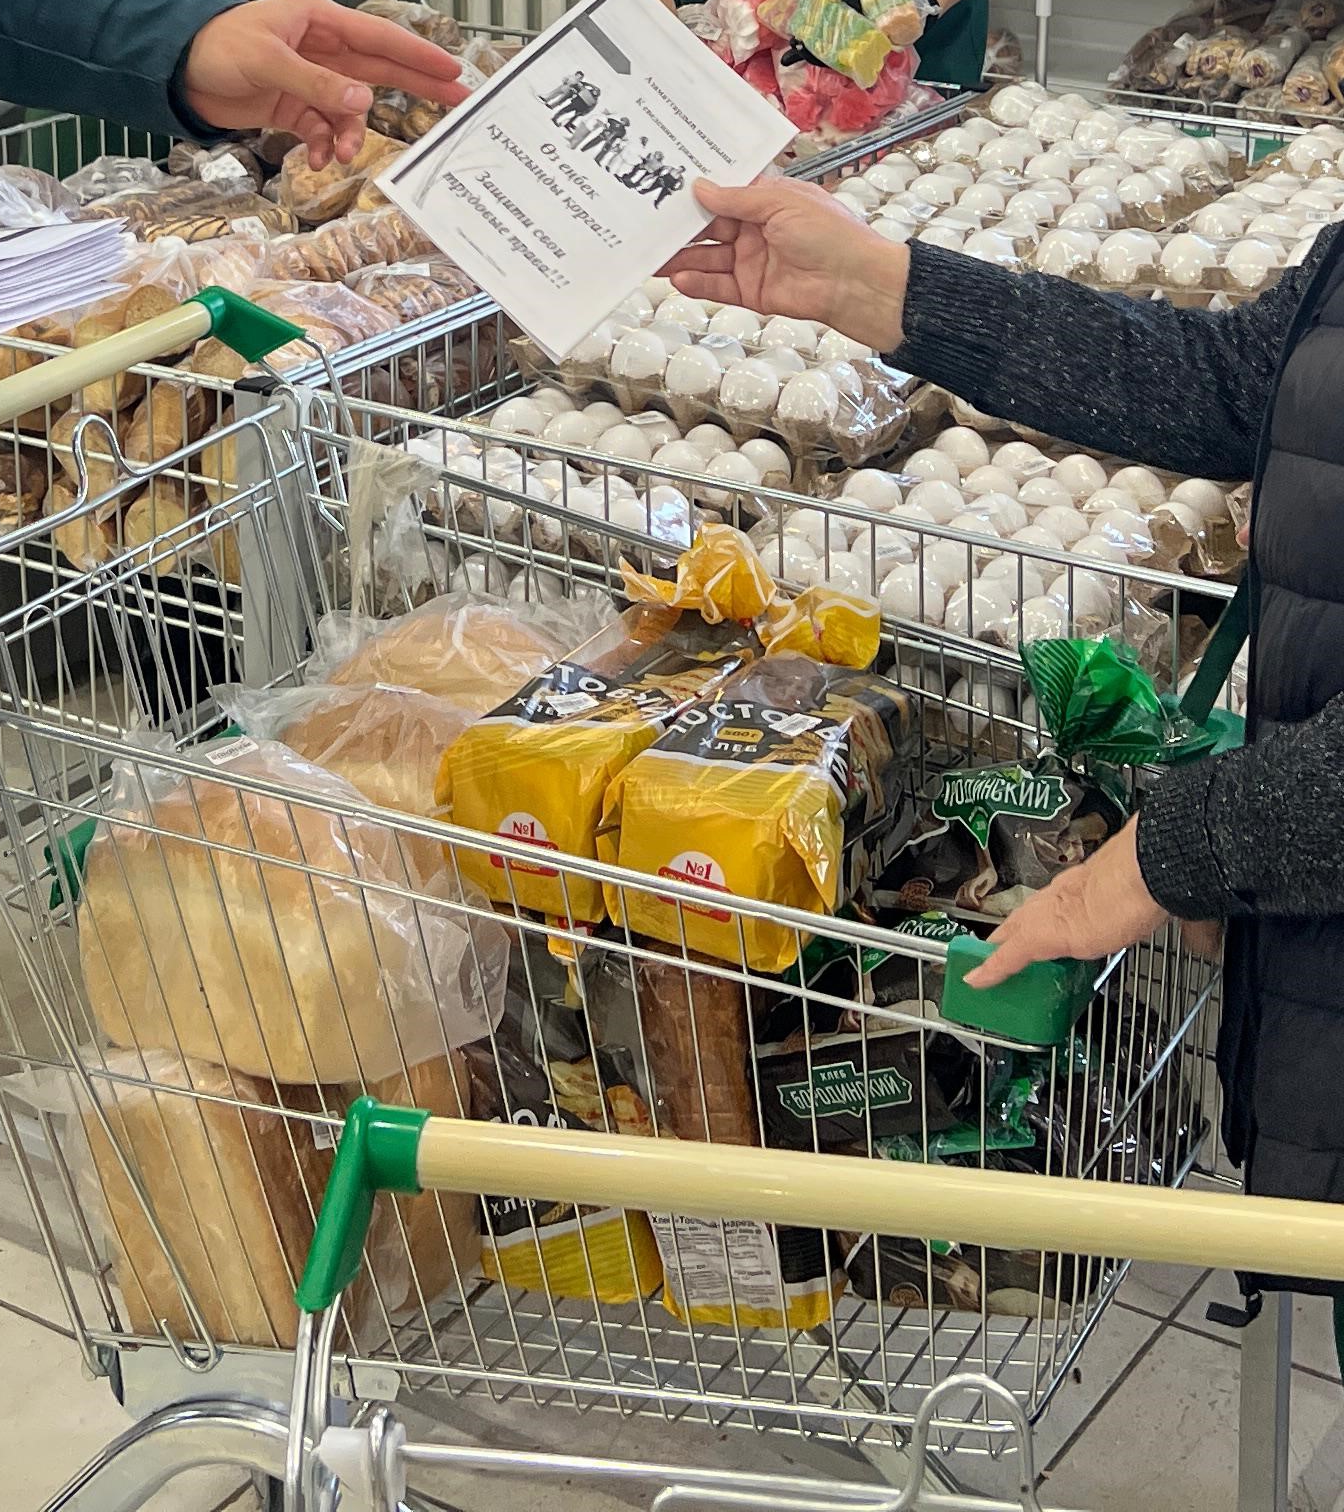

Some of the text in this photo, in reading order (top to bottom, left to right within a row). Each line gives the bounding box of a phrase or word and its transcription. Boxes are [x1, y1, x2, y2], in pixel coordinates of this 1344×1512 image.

[539, 142, 602, 201] Өз еңбек
[475, 170, 535, 229] Защити
[532, 228, 568, 260] свои
[441, 171, 510, 237] трудовые
[507, 234, 571, 290] права!!!
[699, 736, 759, 753] ХЛЕБ
[512, 820, 535, 838] №1
[685, 859, 713, 881] №1
[819, 1069, 847, 1081] ХЛЕБ
